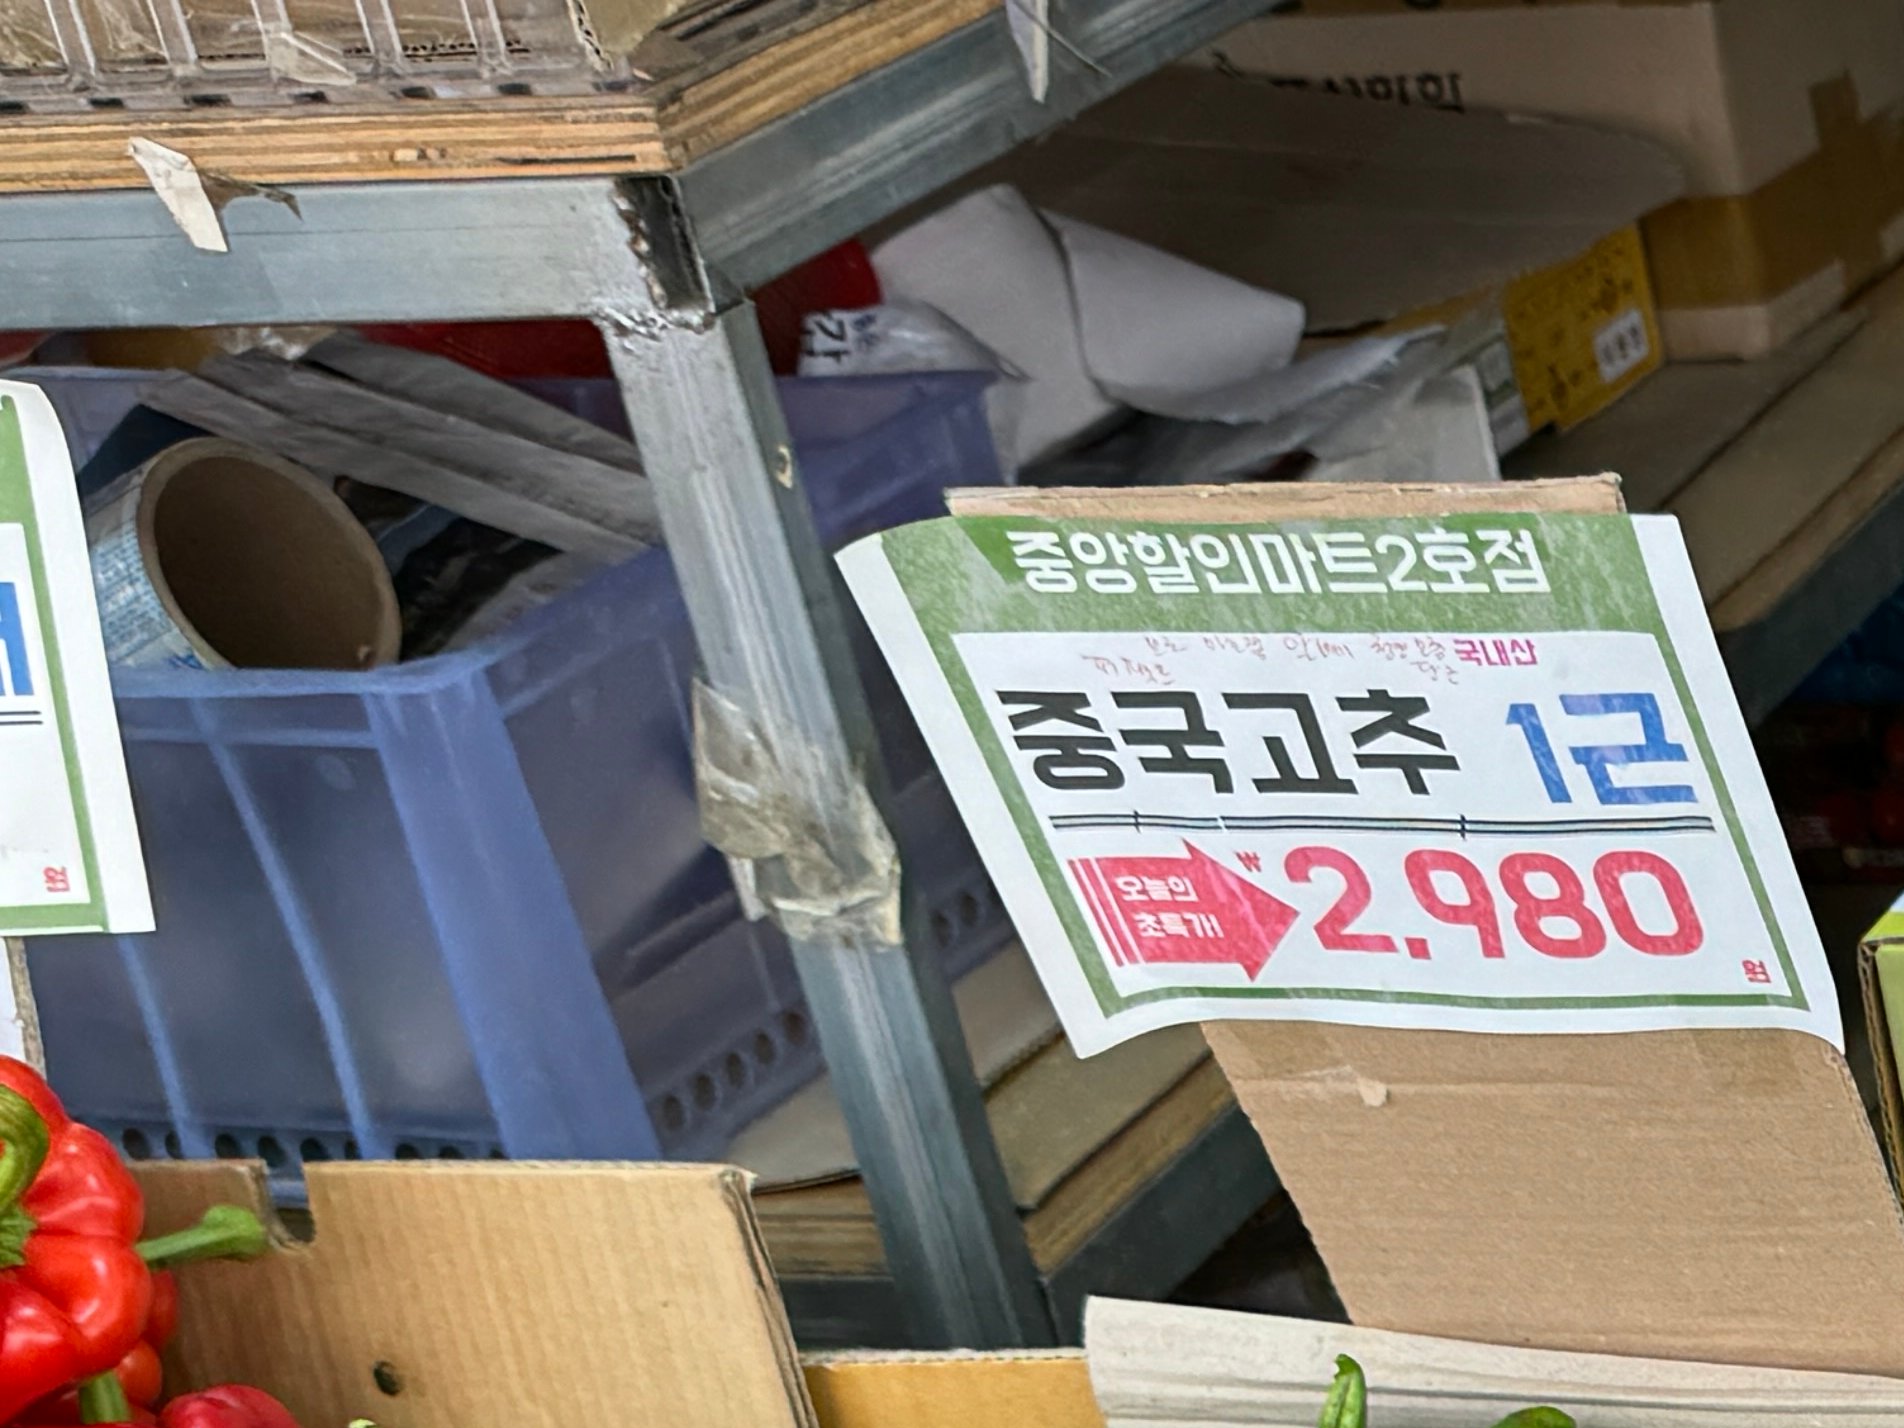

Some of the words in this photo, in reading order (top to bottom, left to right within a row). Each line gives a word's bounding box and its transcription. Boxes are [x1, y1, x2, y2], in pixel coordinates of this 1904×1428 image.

[1006, 528, 1551, 595] 중앙할인마트2호점
[1454, 637, 1537, 667] 국내산
[995, 688, 1460, 796] 중국고추
[1505, 690, 1699, 806] 1근
[43, 865, 71, 893] 원
[1117, 873, 1199, 905] 오늘의
[1136, 910, 1220, 942] 초특가!
[1284, 844, 1706, 962] 2.980
[1742, 958, 1772, 986] 원
